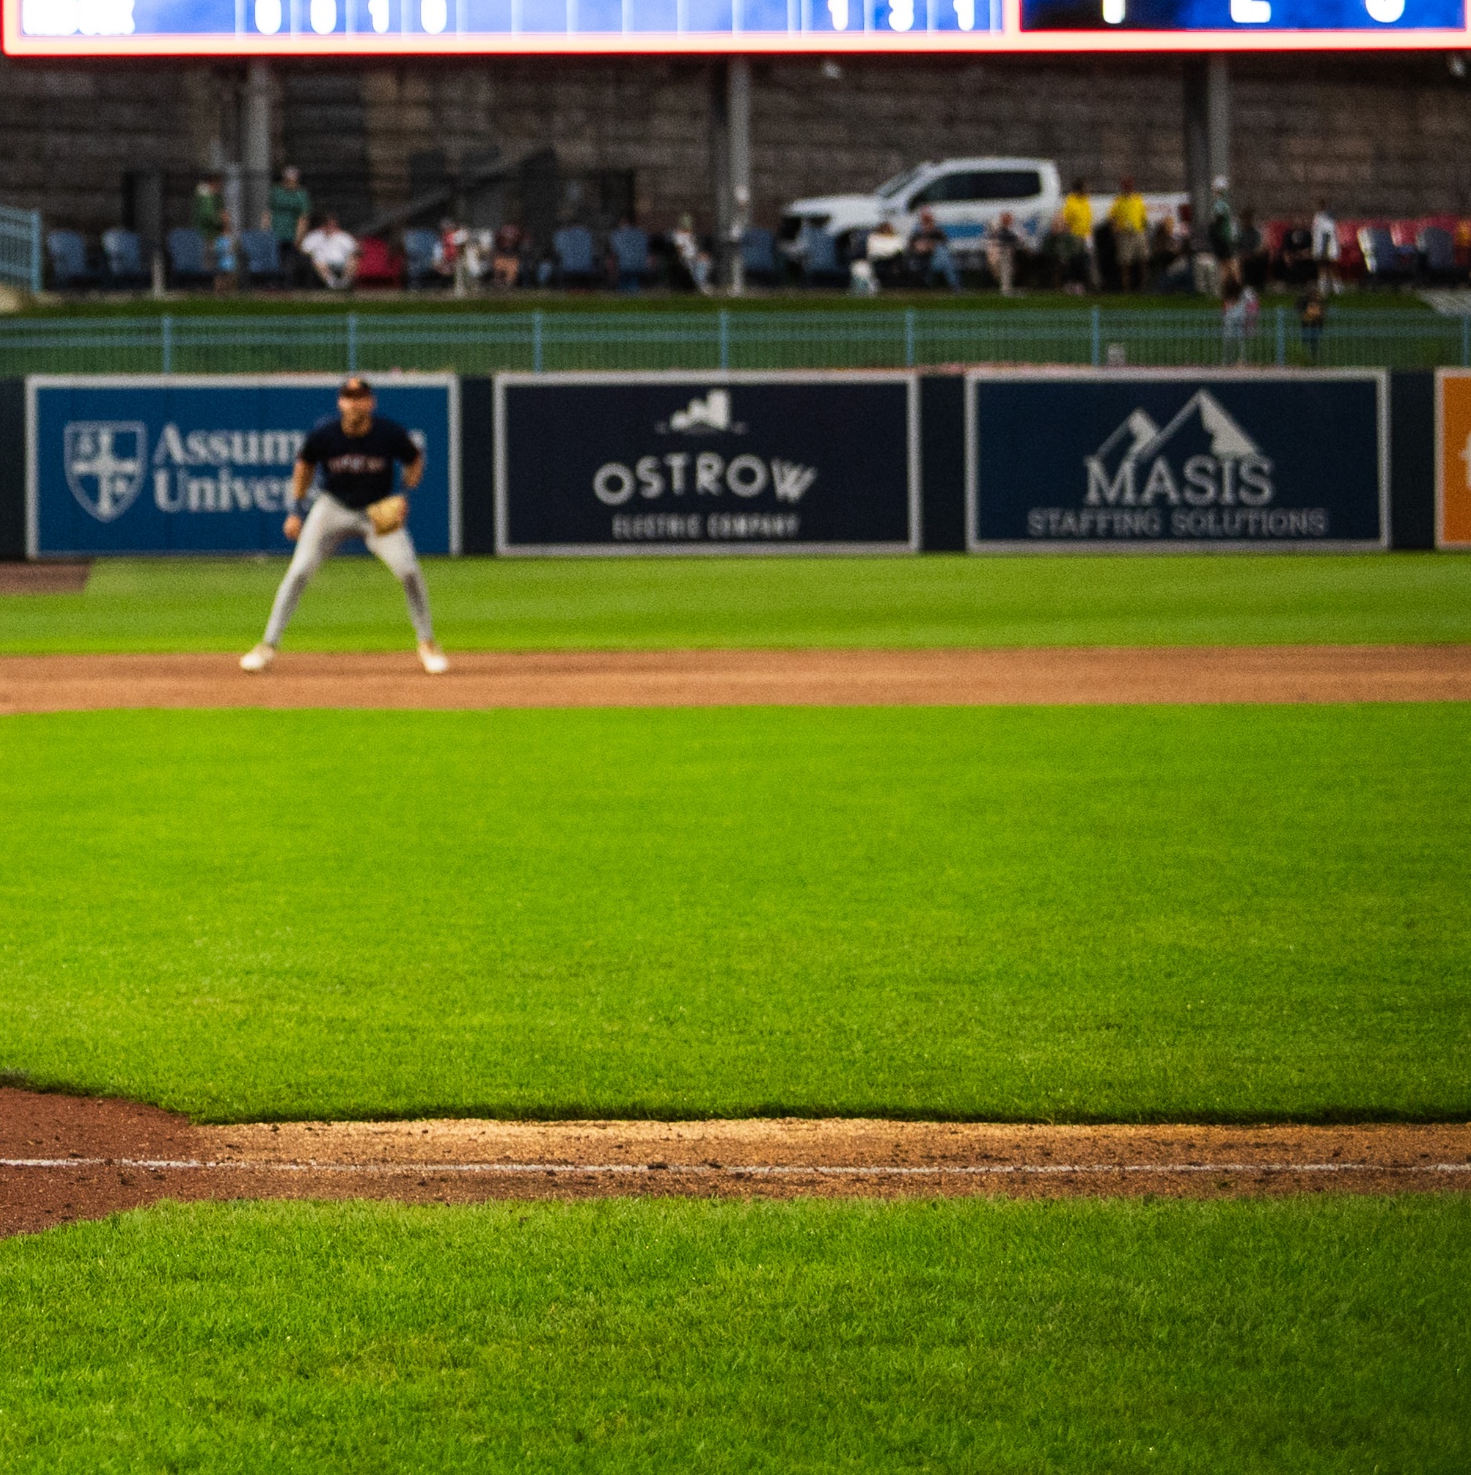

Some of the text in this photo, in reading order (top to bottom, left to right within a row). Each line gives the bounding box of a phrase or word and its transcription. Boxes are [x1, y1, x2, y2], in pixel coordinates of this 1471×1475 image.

[592, 450, 818, 506] OSTROW
[1083, 454, 1275, 507] MASIS
[1026, 506, 1330, 537] STAFFING SOLUTIONS
